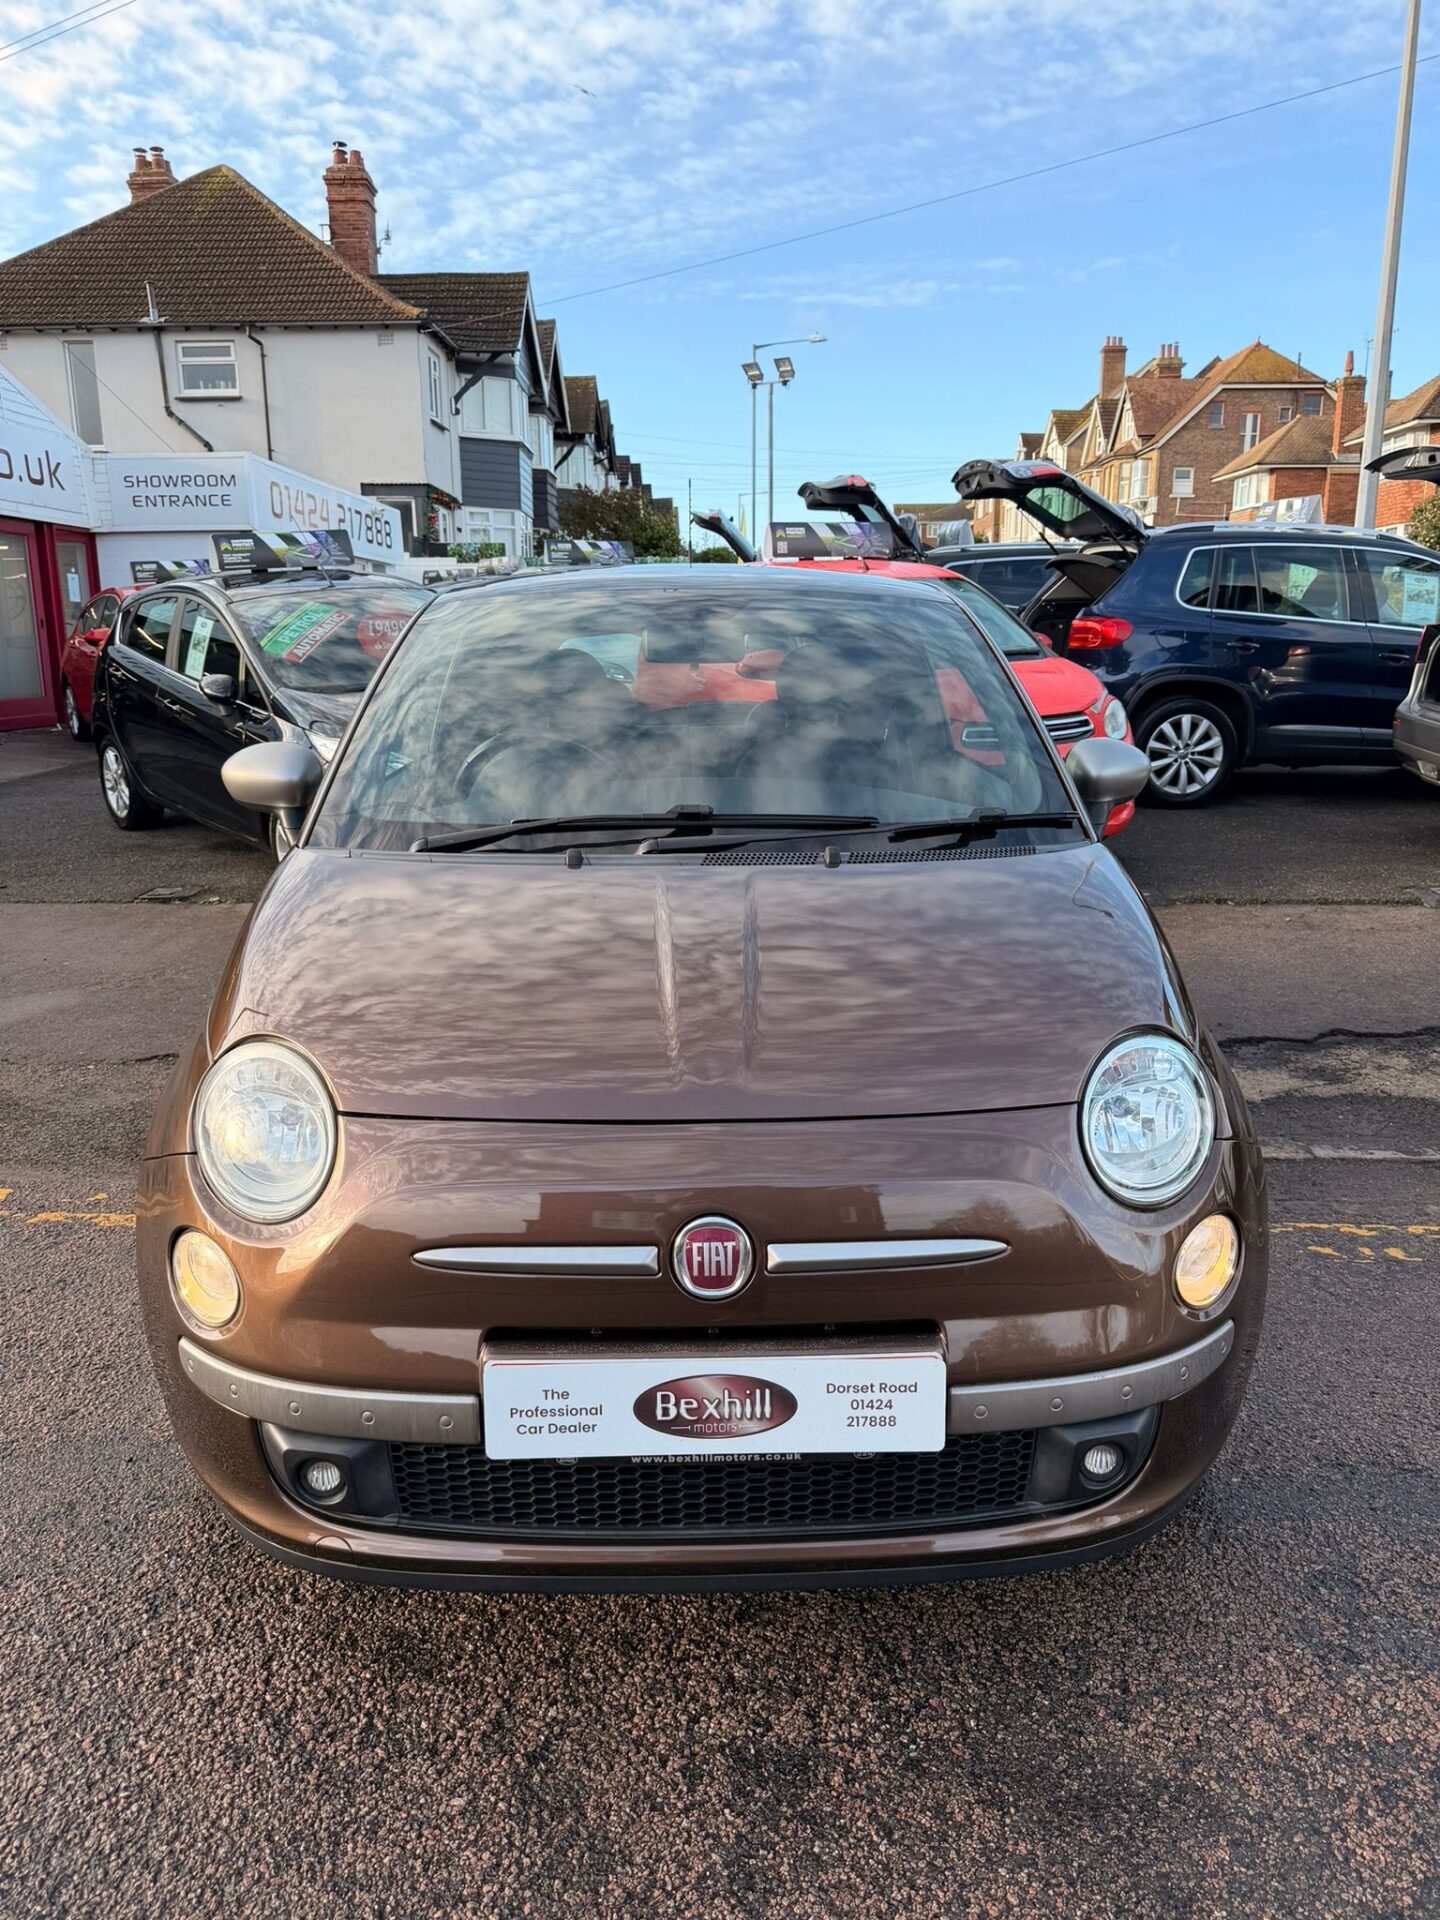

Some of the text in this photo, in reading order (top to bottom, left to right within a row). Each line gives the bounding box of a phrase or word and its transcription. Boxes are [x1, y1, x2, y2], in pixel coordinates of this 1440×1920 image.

[123, 474, 237, 489] SHOWROOM
[132, 493, 232, 508] ENTRANCE
[270, 480, 393, 549] 01424 217888
[277, 611, 324, 644] PETROL
[292, 612, 347, 657] AUTOMATIC
[692, 1241, 737, 1277] FIAT
[542, 1388, 570, 1401] The
[826, 1381, 918, 1394] Dorset Road
[509, 1404, 604, 1419] Professional
[655, 1387, 772, 1421] Bexhill
[850, 1398, 893, 1411] 01424
[516, 1421, 597, 1436] Car Dealer
[693, 1422, 738, 1434] motors
[846, 1415, 897, 1428] 217888
[631, 1452, 802, 1464] www.bexhillmotors.co.uk
